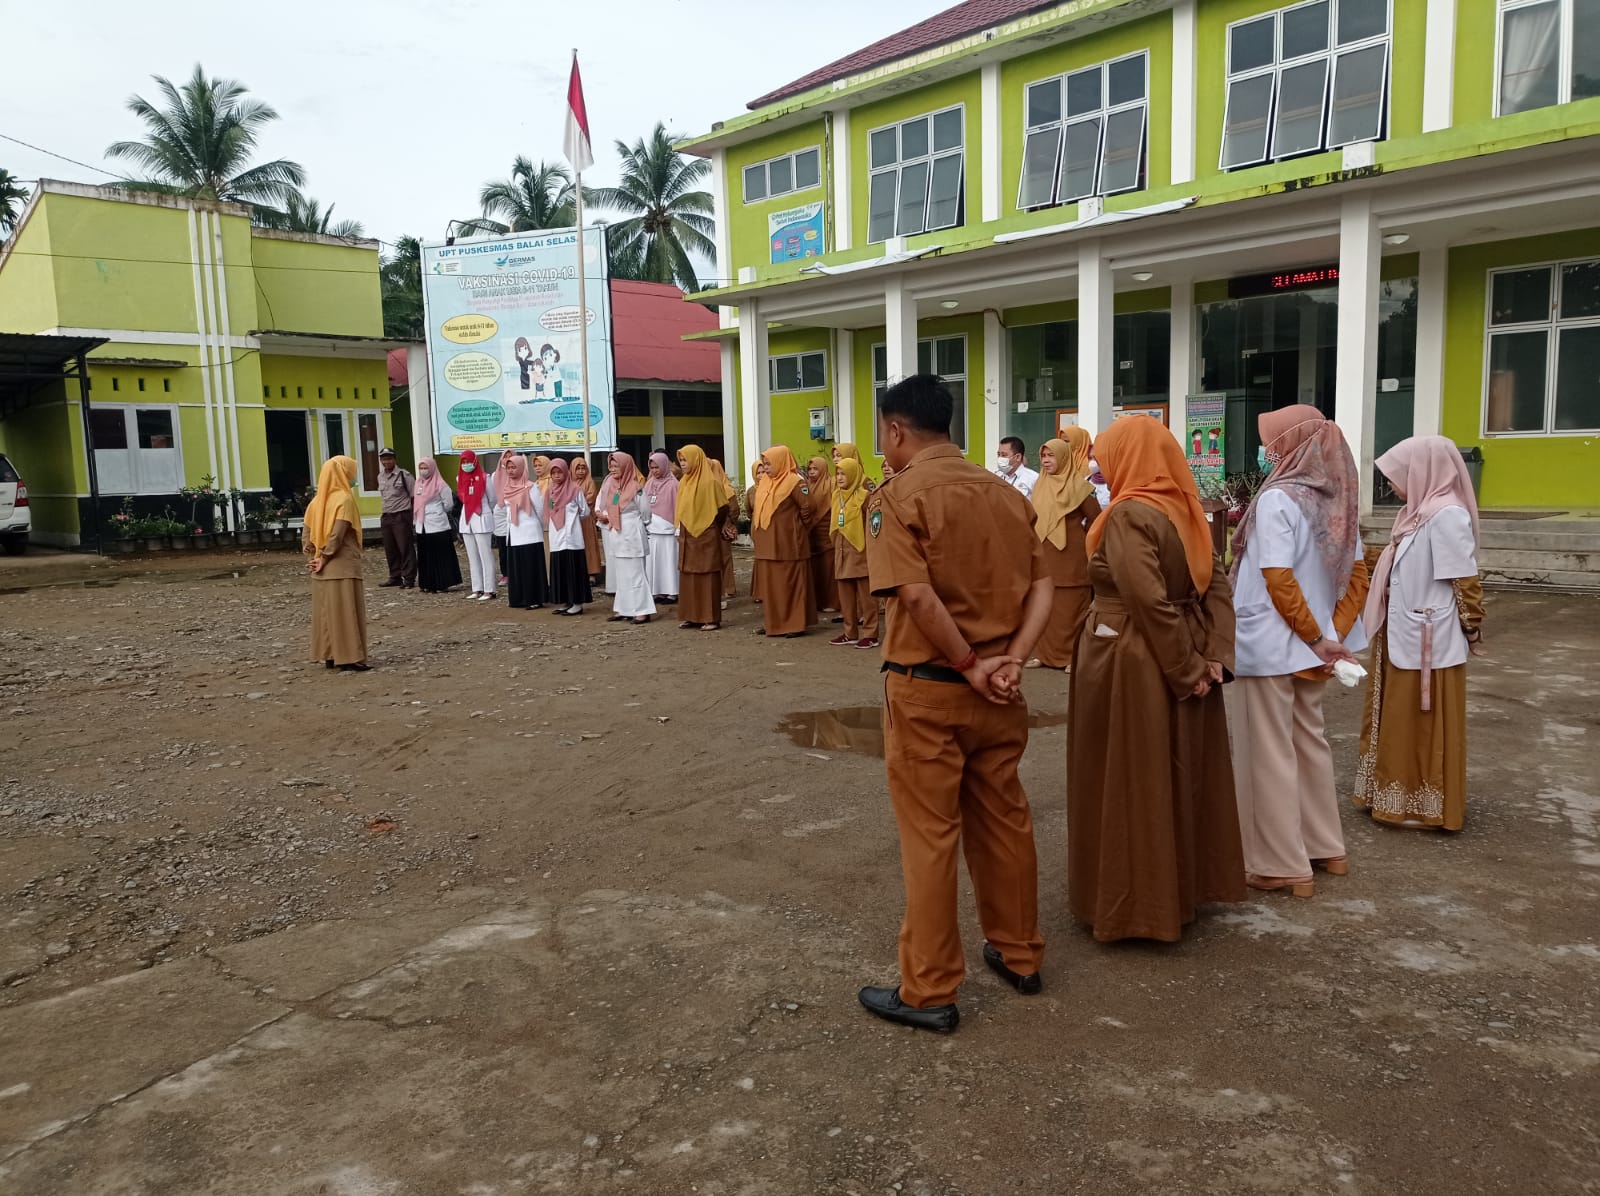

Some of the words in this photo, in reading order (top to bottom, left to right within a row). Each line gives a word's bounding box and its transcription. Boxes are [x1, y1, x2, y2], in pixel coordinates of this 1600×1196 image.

[439, 249, 457, 258] UPT
[458, 244, 514, 256] PUSKESMAS
[516, 240, 544, 250] BALAI
[546, 236, 577, 246] SELAS
[457, 271, 519, 291] VAKSINASI
[522, 266, 576, 285] COVID-19
